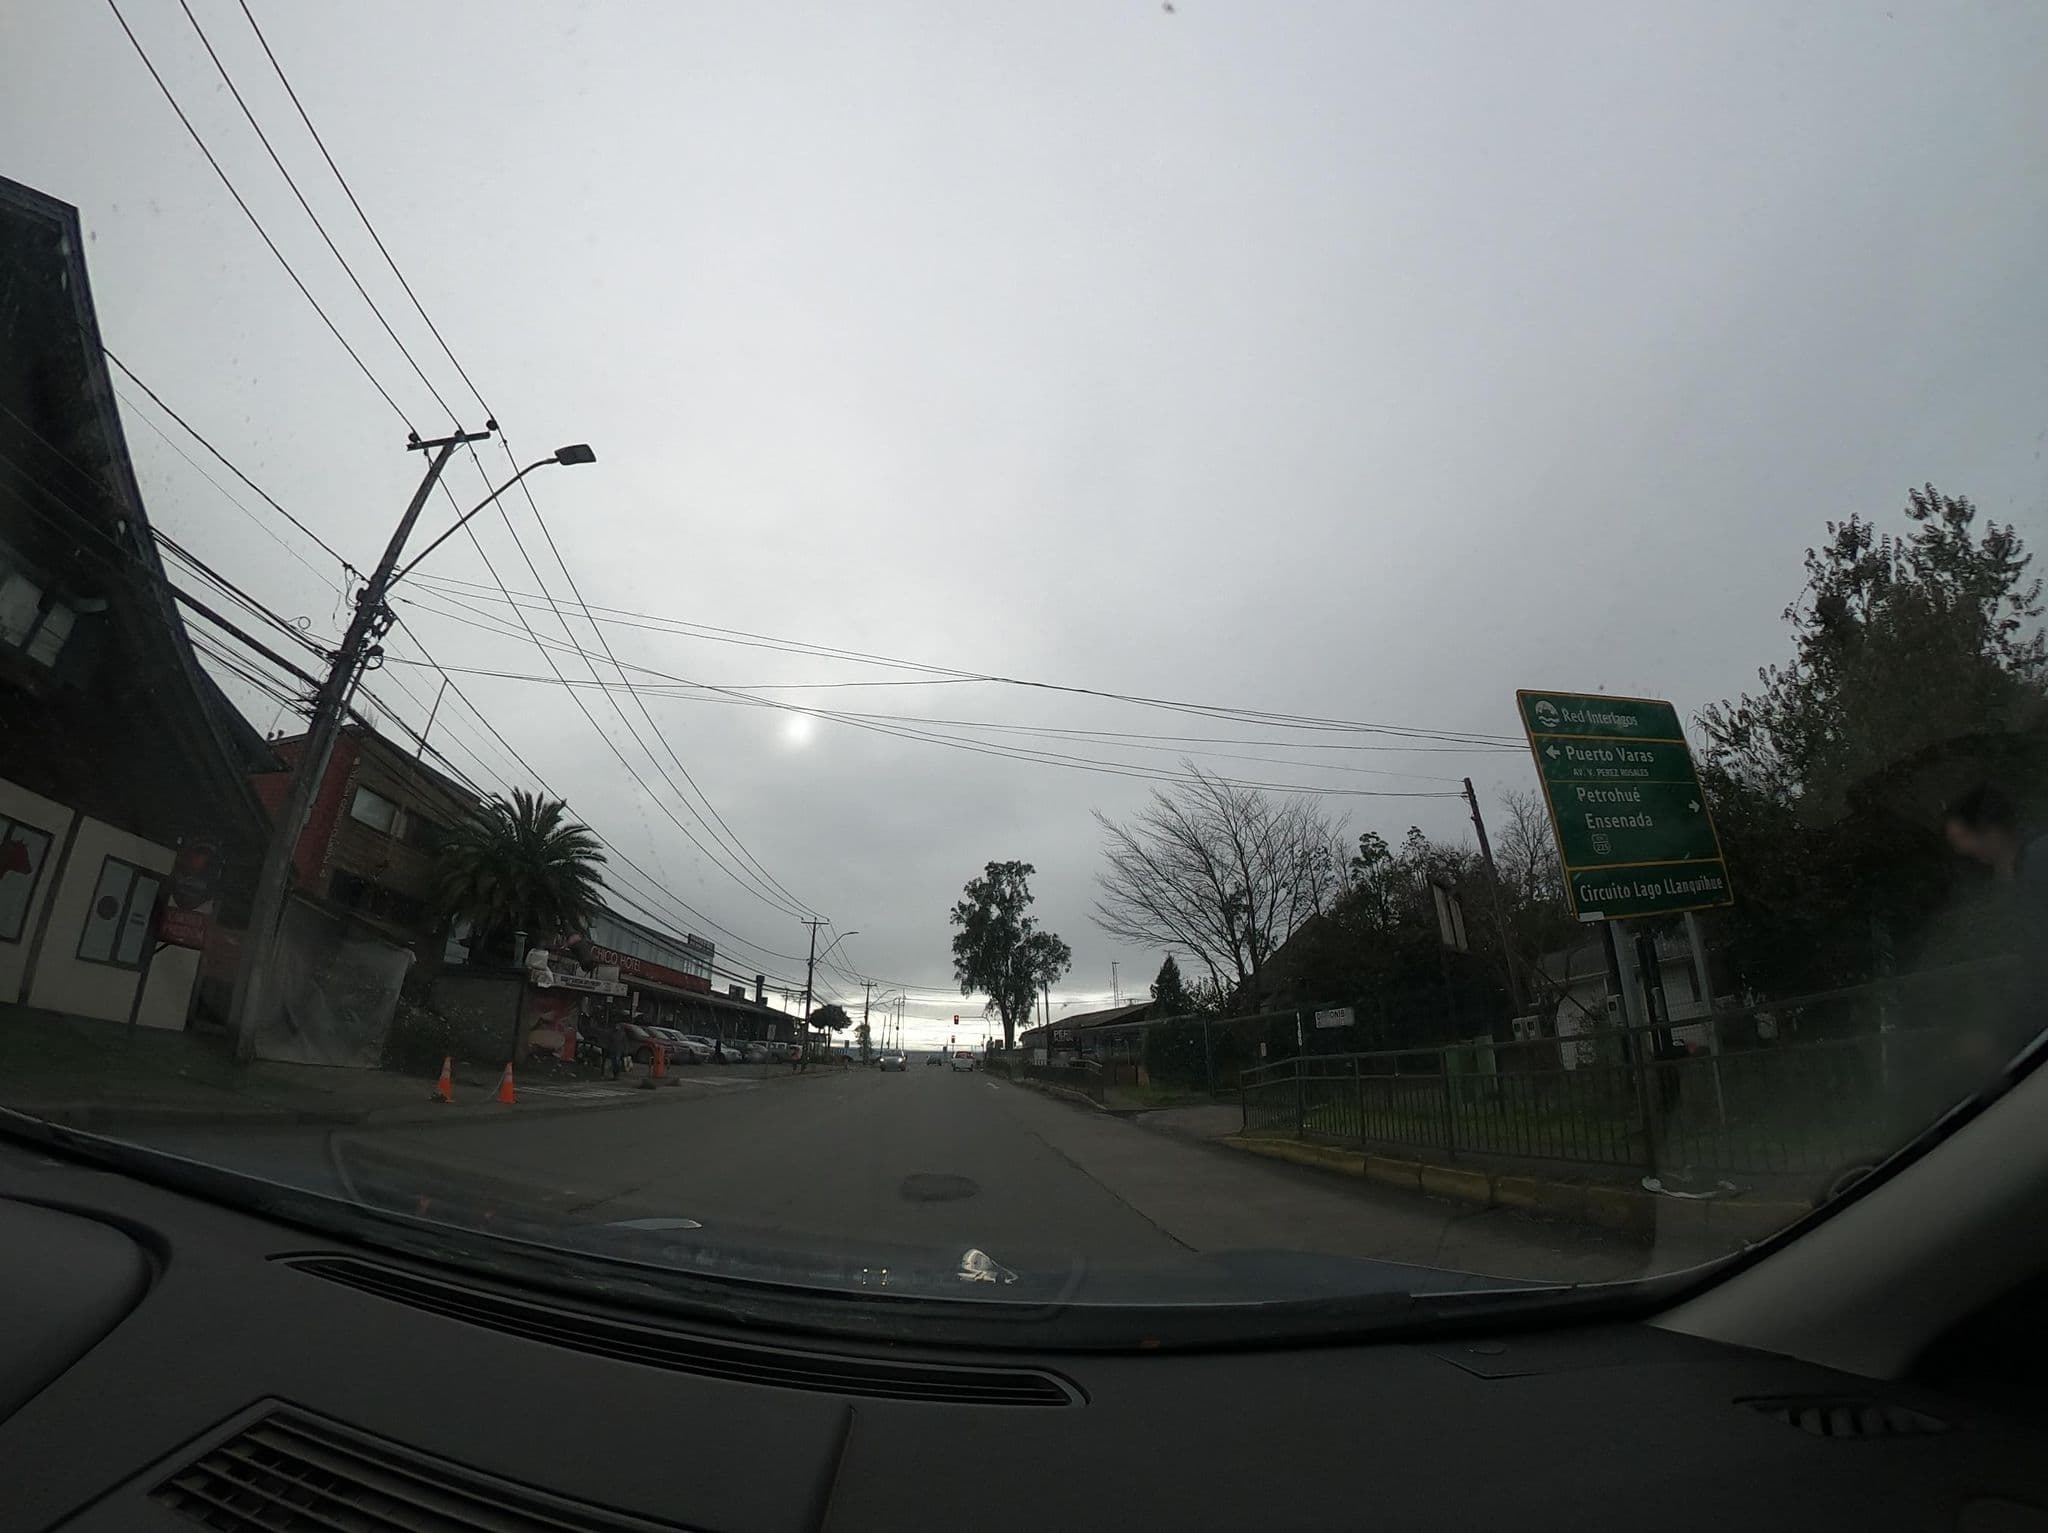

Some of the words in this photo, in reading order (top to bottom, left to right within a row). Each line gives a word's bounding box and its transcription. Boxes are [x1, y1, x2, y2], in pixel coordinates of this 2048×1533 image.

[1561, 707, 1585, 723] Red
[1586, 709, 1638, 728] Interlagos
[1566, 745, 1613, 762] Puerto
[1615, 746, 1655, 763] Varas
[1576, 785, 1641, 803] Petrohué
[1585, 813, 1653, 830] Ensenada
[1580, 882, 1631, 902] Circuito
[1633, 880, 1662, 900] Lago
[620, 954, 641, 972] HOTEL
